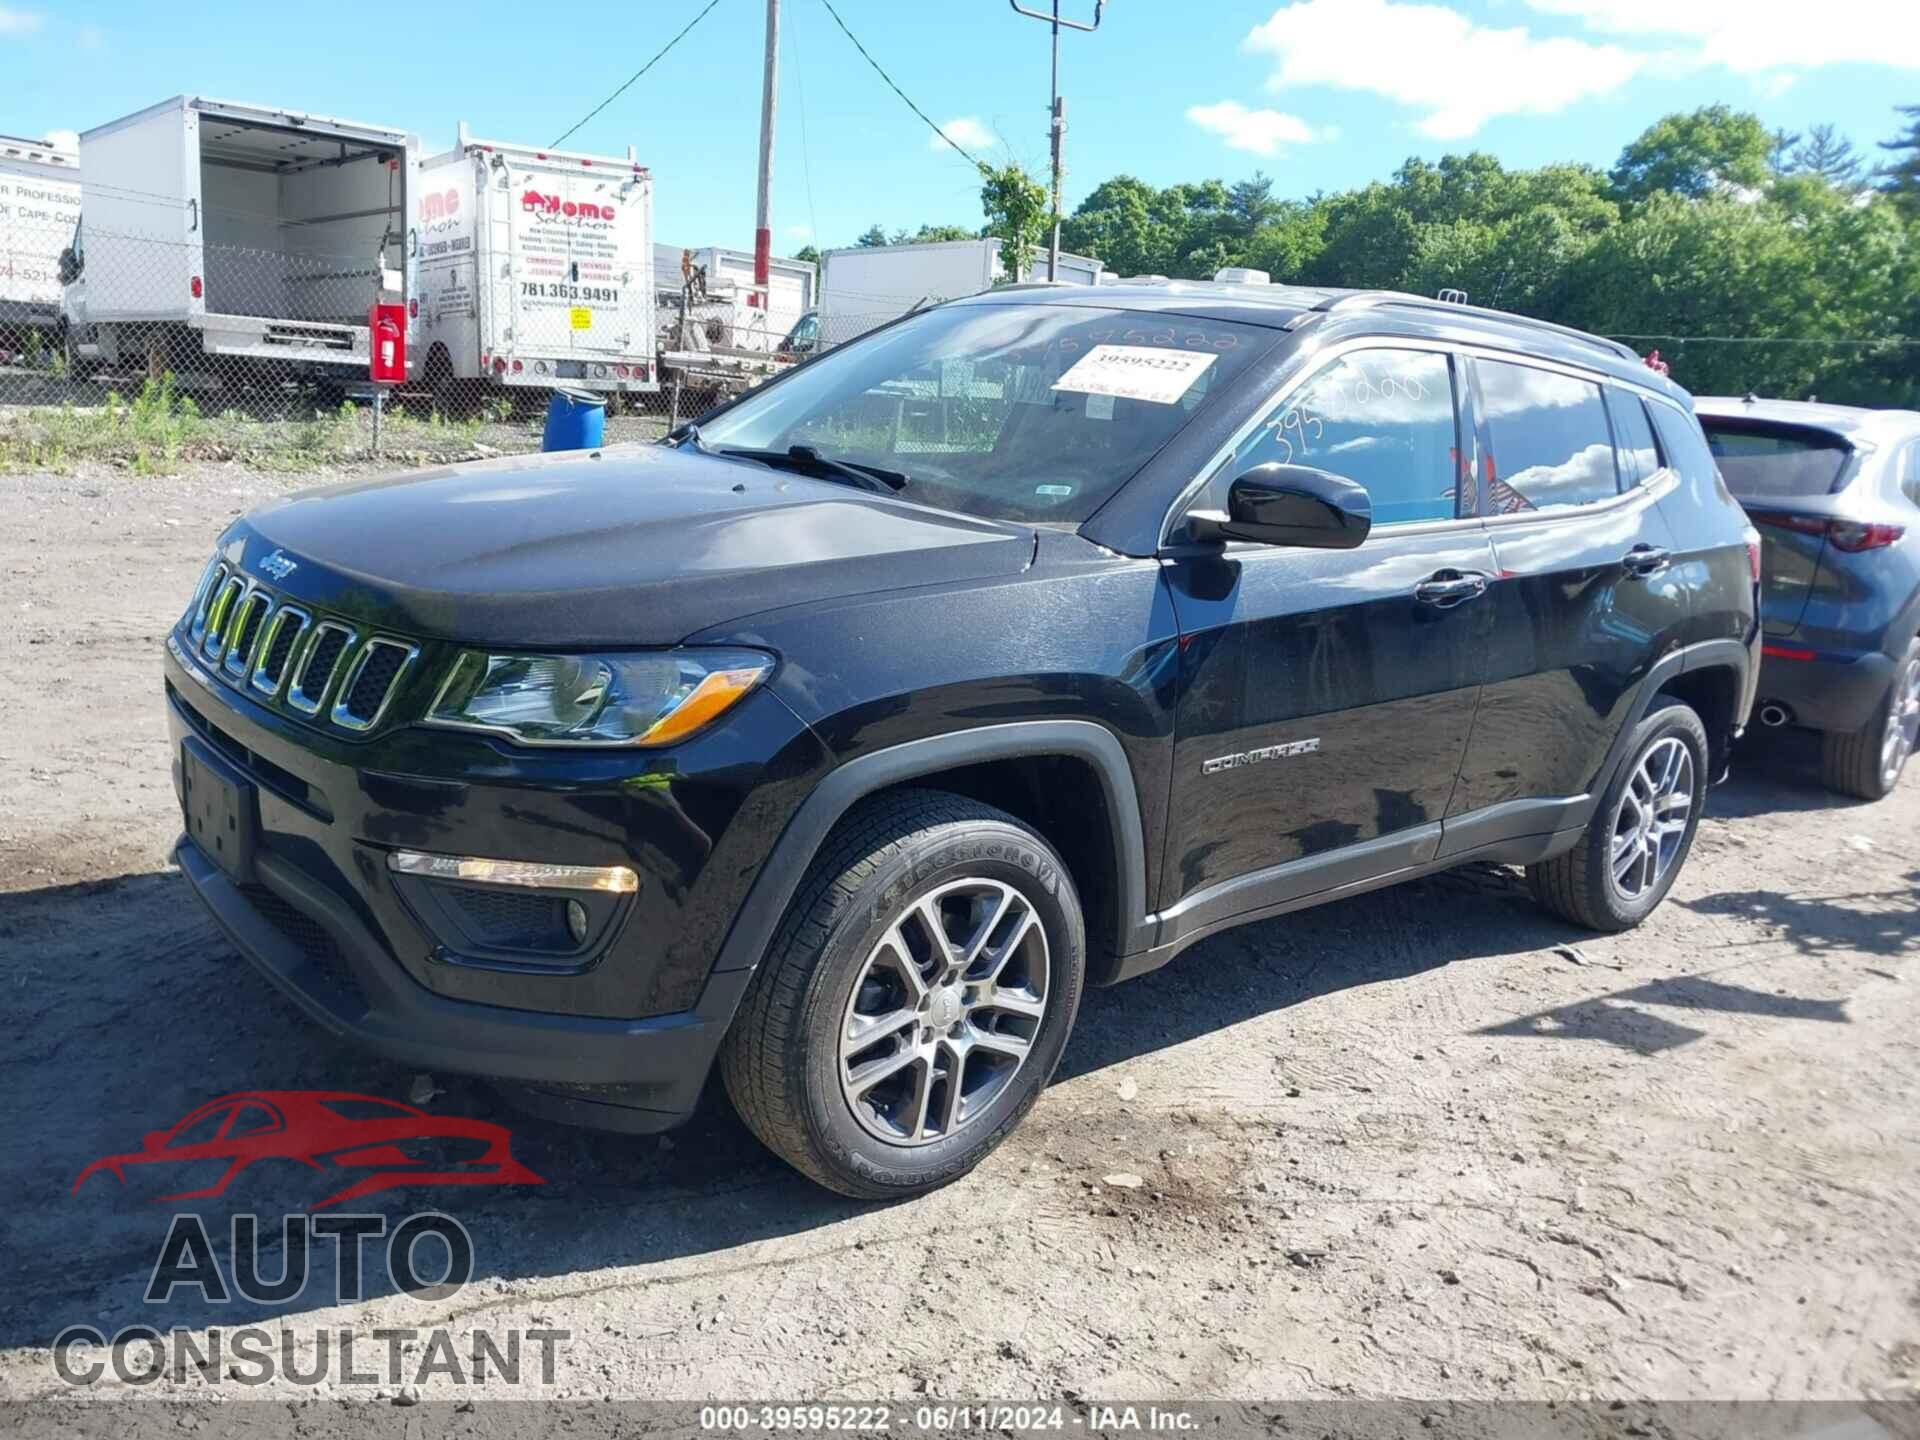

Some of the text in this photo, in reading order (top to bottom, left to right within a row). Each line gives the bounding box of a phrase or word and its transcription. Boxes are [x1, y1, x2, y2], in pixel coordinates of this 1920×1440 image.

[18, 206, 50, 222] CAPE
[543, 194, 615, 221] Home
[520, 281, 618, 303] 781.363.9491
